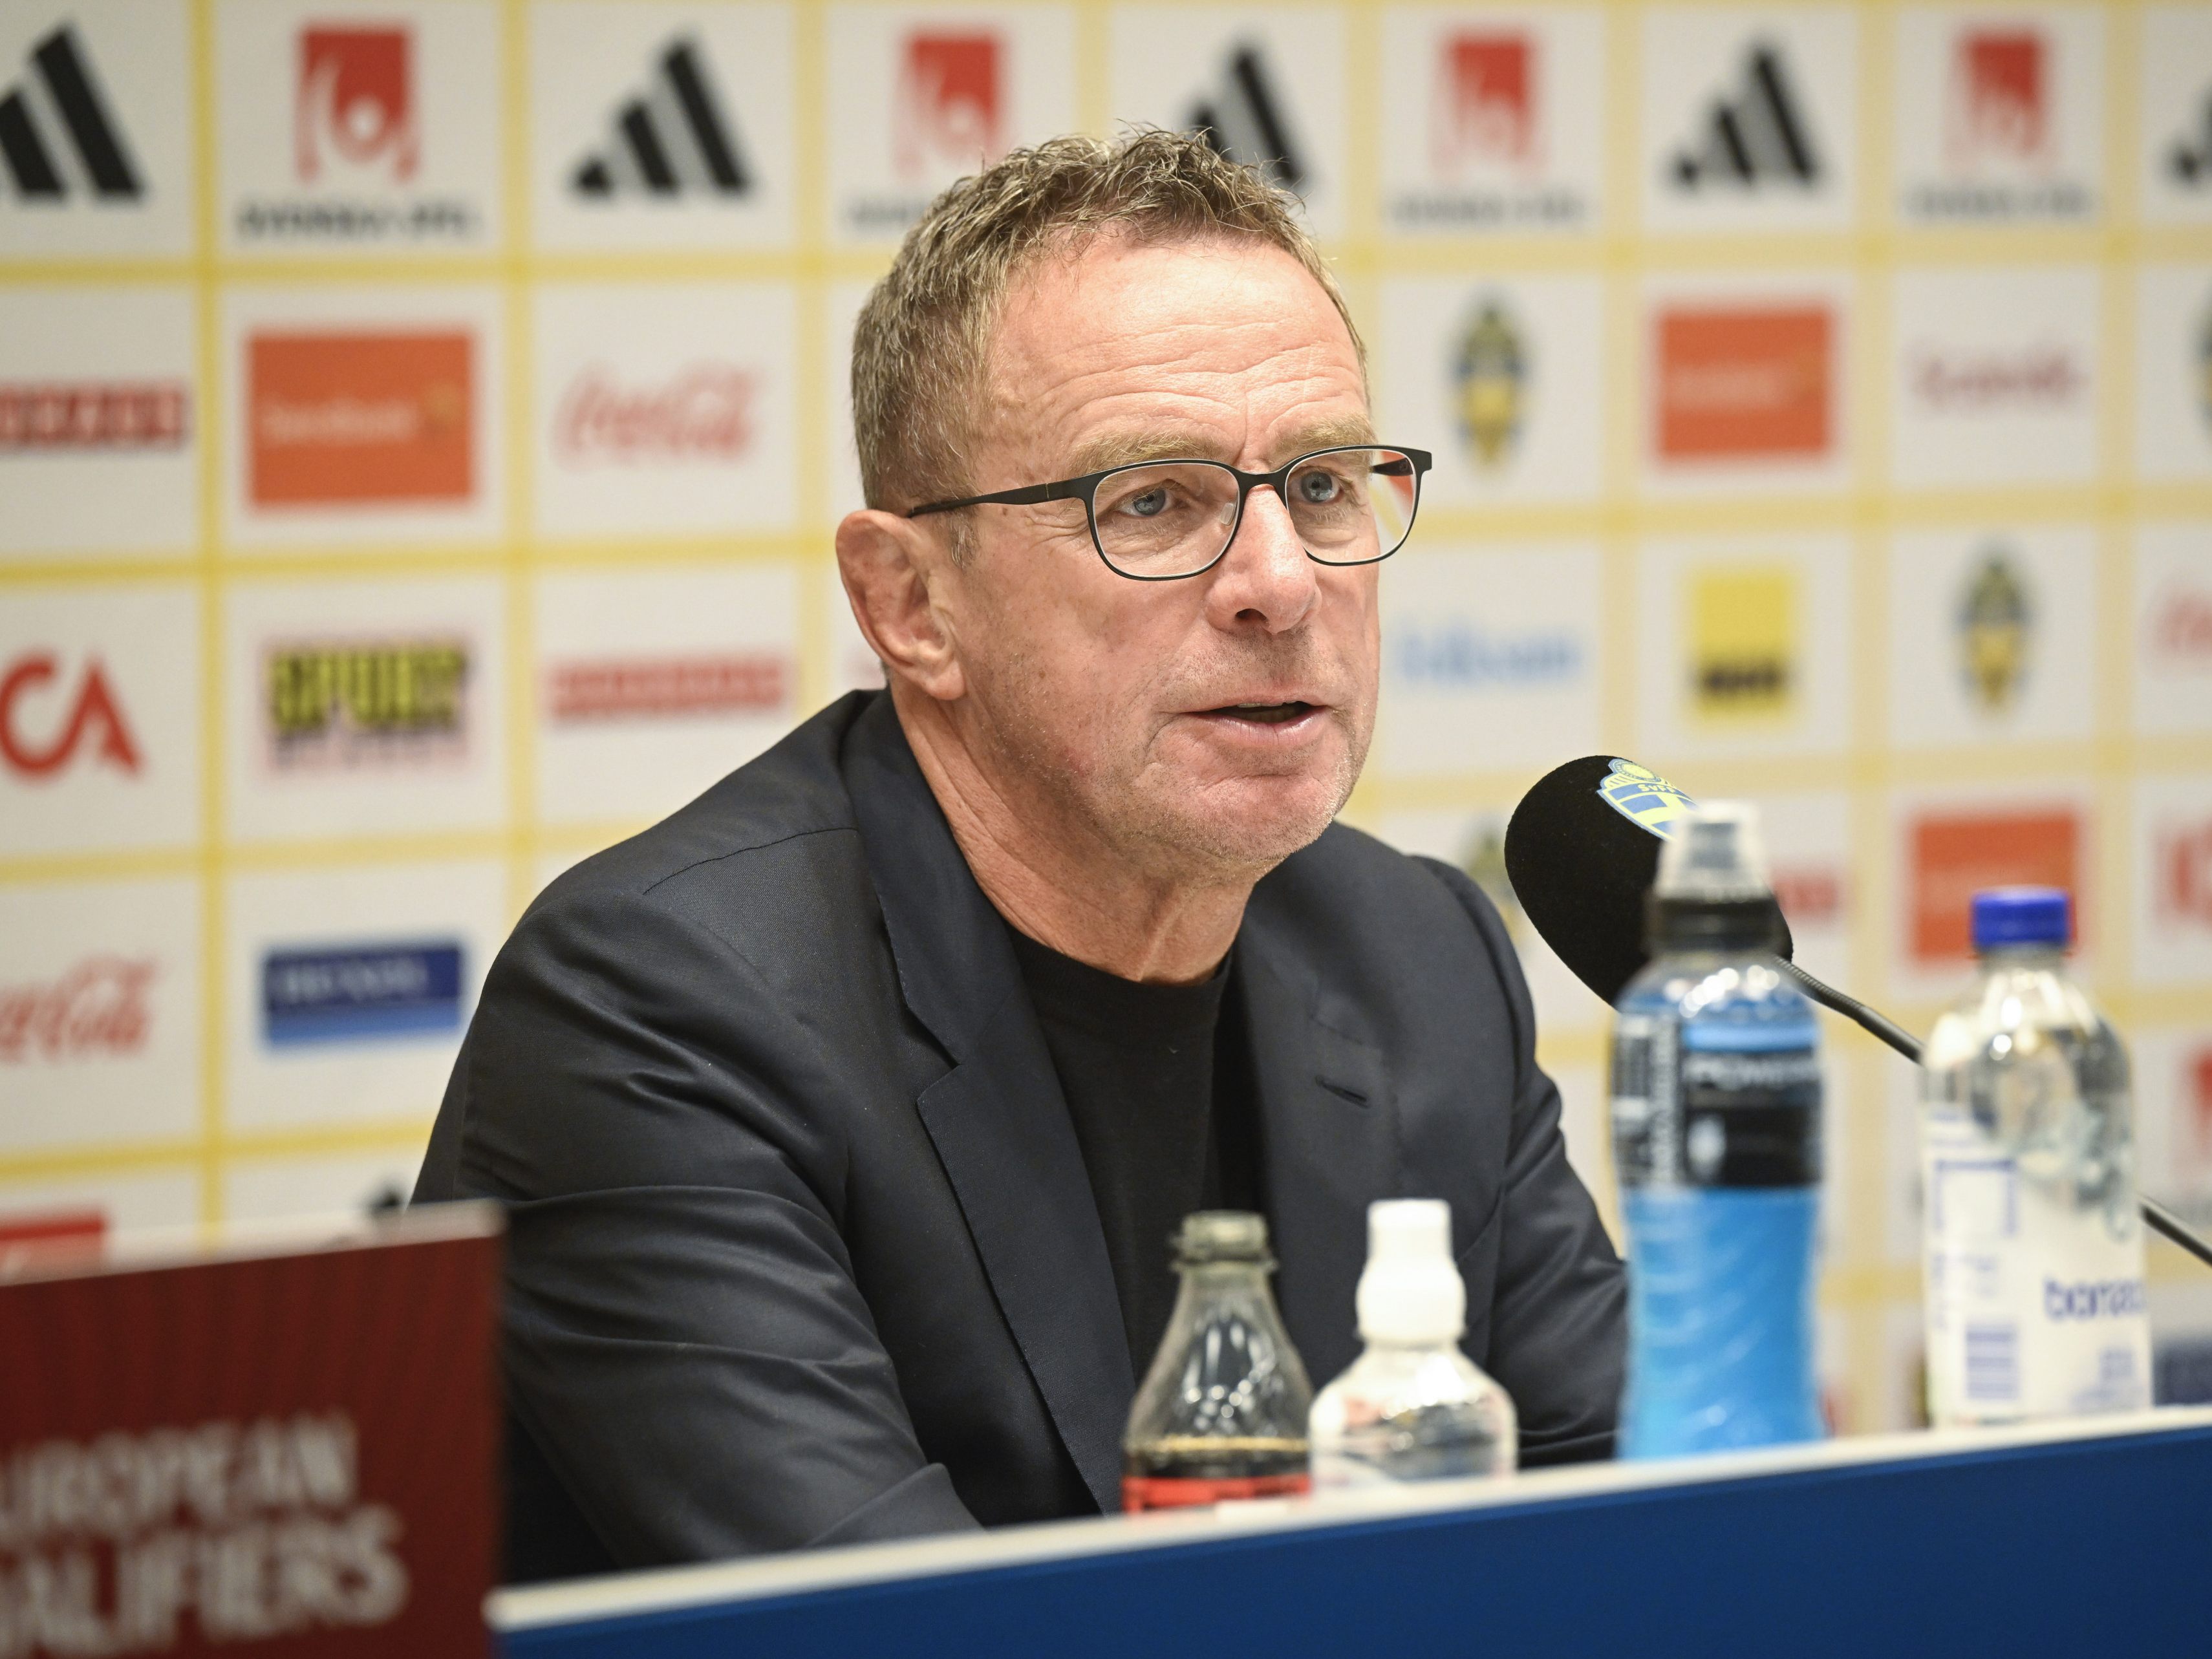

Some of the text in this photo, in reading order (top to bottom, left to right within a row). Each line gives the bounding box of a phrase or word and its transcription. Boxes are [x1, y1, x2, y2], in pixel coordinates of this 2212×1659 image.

[0, 658, 138, 776] CA
[0, 1415, 355, 1539] UROPEAN
[0, 1505, 407, 1653] ALIFIERS
